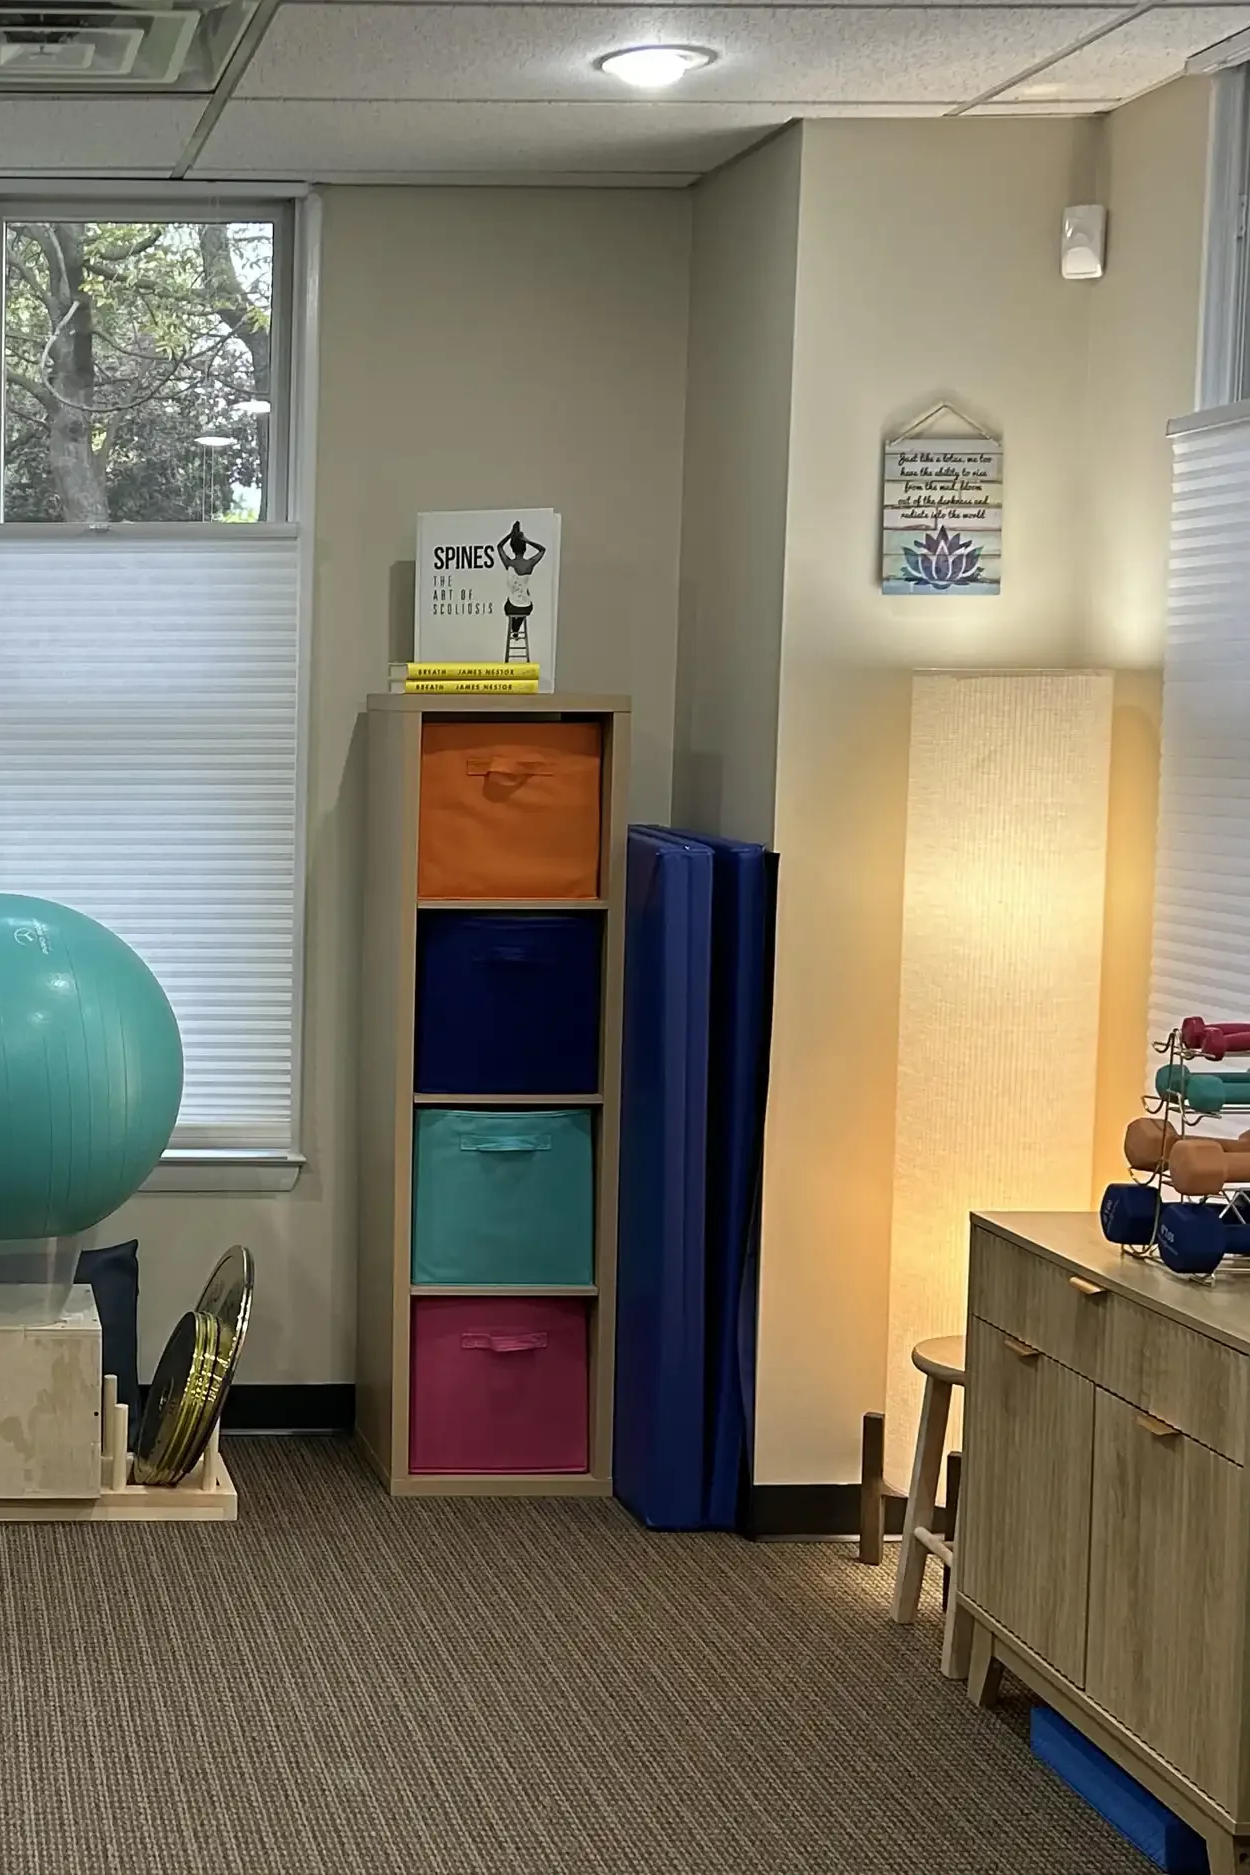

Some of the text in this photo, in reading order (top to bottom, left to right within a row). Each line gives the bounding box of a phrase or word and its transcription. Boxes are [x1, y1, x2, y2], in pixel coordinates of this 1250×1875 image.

[898, 452, 918, 466] Just
[919, 453, 934, 463] like
[979, 453, 992, 463] too
[900, 467, 988, 481] have the ability to rise
[904, 481, 923, 493] from
[925, 480, 937, 491] the
[959, 480, 982, 491] bloom
[897, 495, 990, 508] out of the darkness and
[900, 509, 986, 519] radiate into the world
[434, 545, 494, 570] SPINES
[433, 575, 452, 587] THE
[433, 588, 473, 601] ART OF
[433, 602, 493, 615] SCOLIOSIS
[458, 668, 482, 676] JAMES
[485, 668, 514, 676] NESTOR
[415, 683, 512, 691] BREATH JAMES NESTOR
